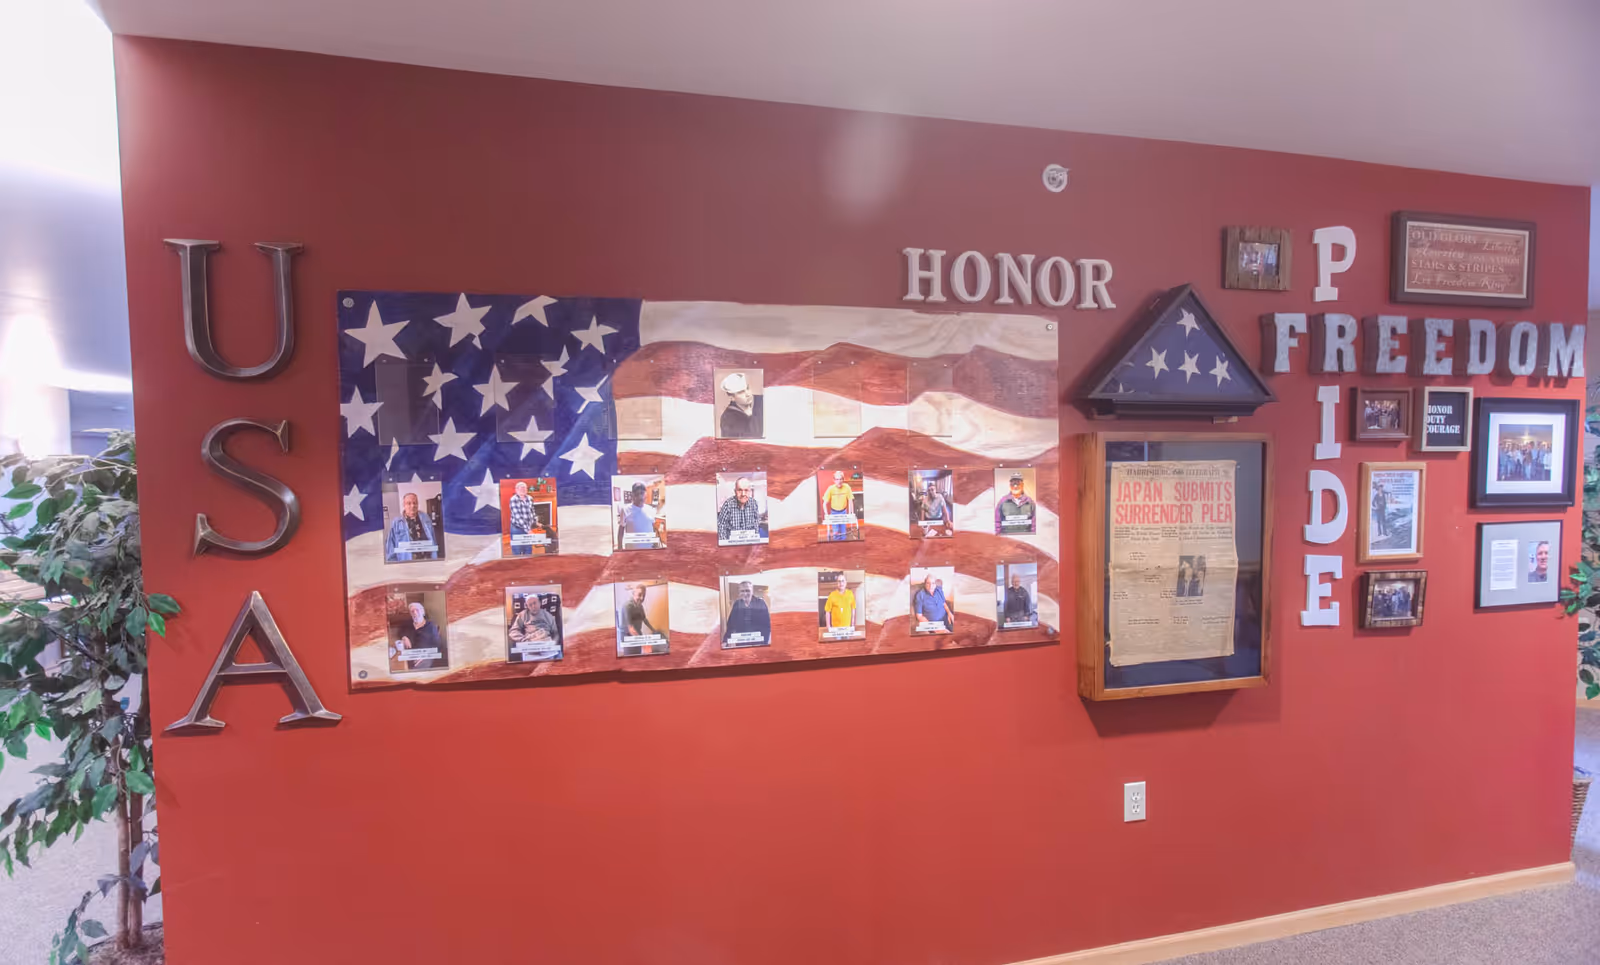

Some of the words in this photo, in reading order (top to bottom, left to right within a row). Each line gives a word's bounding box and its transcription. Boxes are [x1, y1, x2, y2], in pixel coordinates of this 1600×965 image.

[1411, 230, 1436, 241] OLD
[1411, 259, 1445, 270] STARS
[1459, 262, 1505, 273] STRIPES
[903, 247, 1116, 309] HONOR
[1270, 312, 1586, 378] FREEDOM
[163, 238, 343, 731] USA
[1116, 480, 1163, 502] JAPAN
[1174, 480, 1233, 502] SUBMITS
[1115, 503, 1193, 525] SURRENDER
[1202, 503, 1233, 523] PLEA
